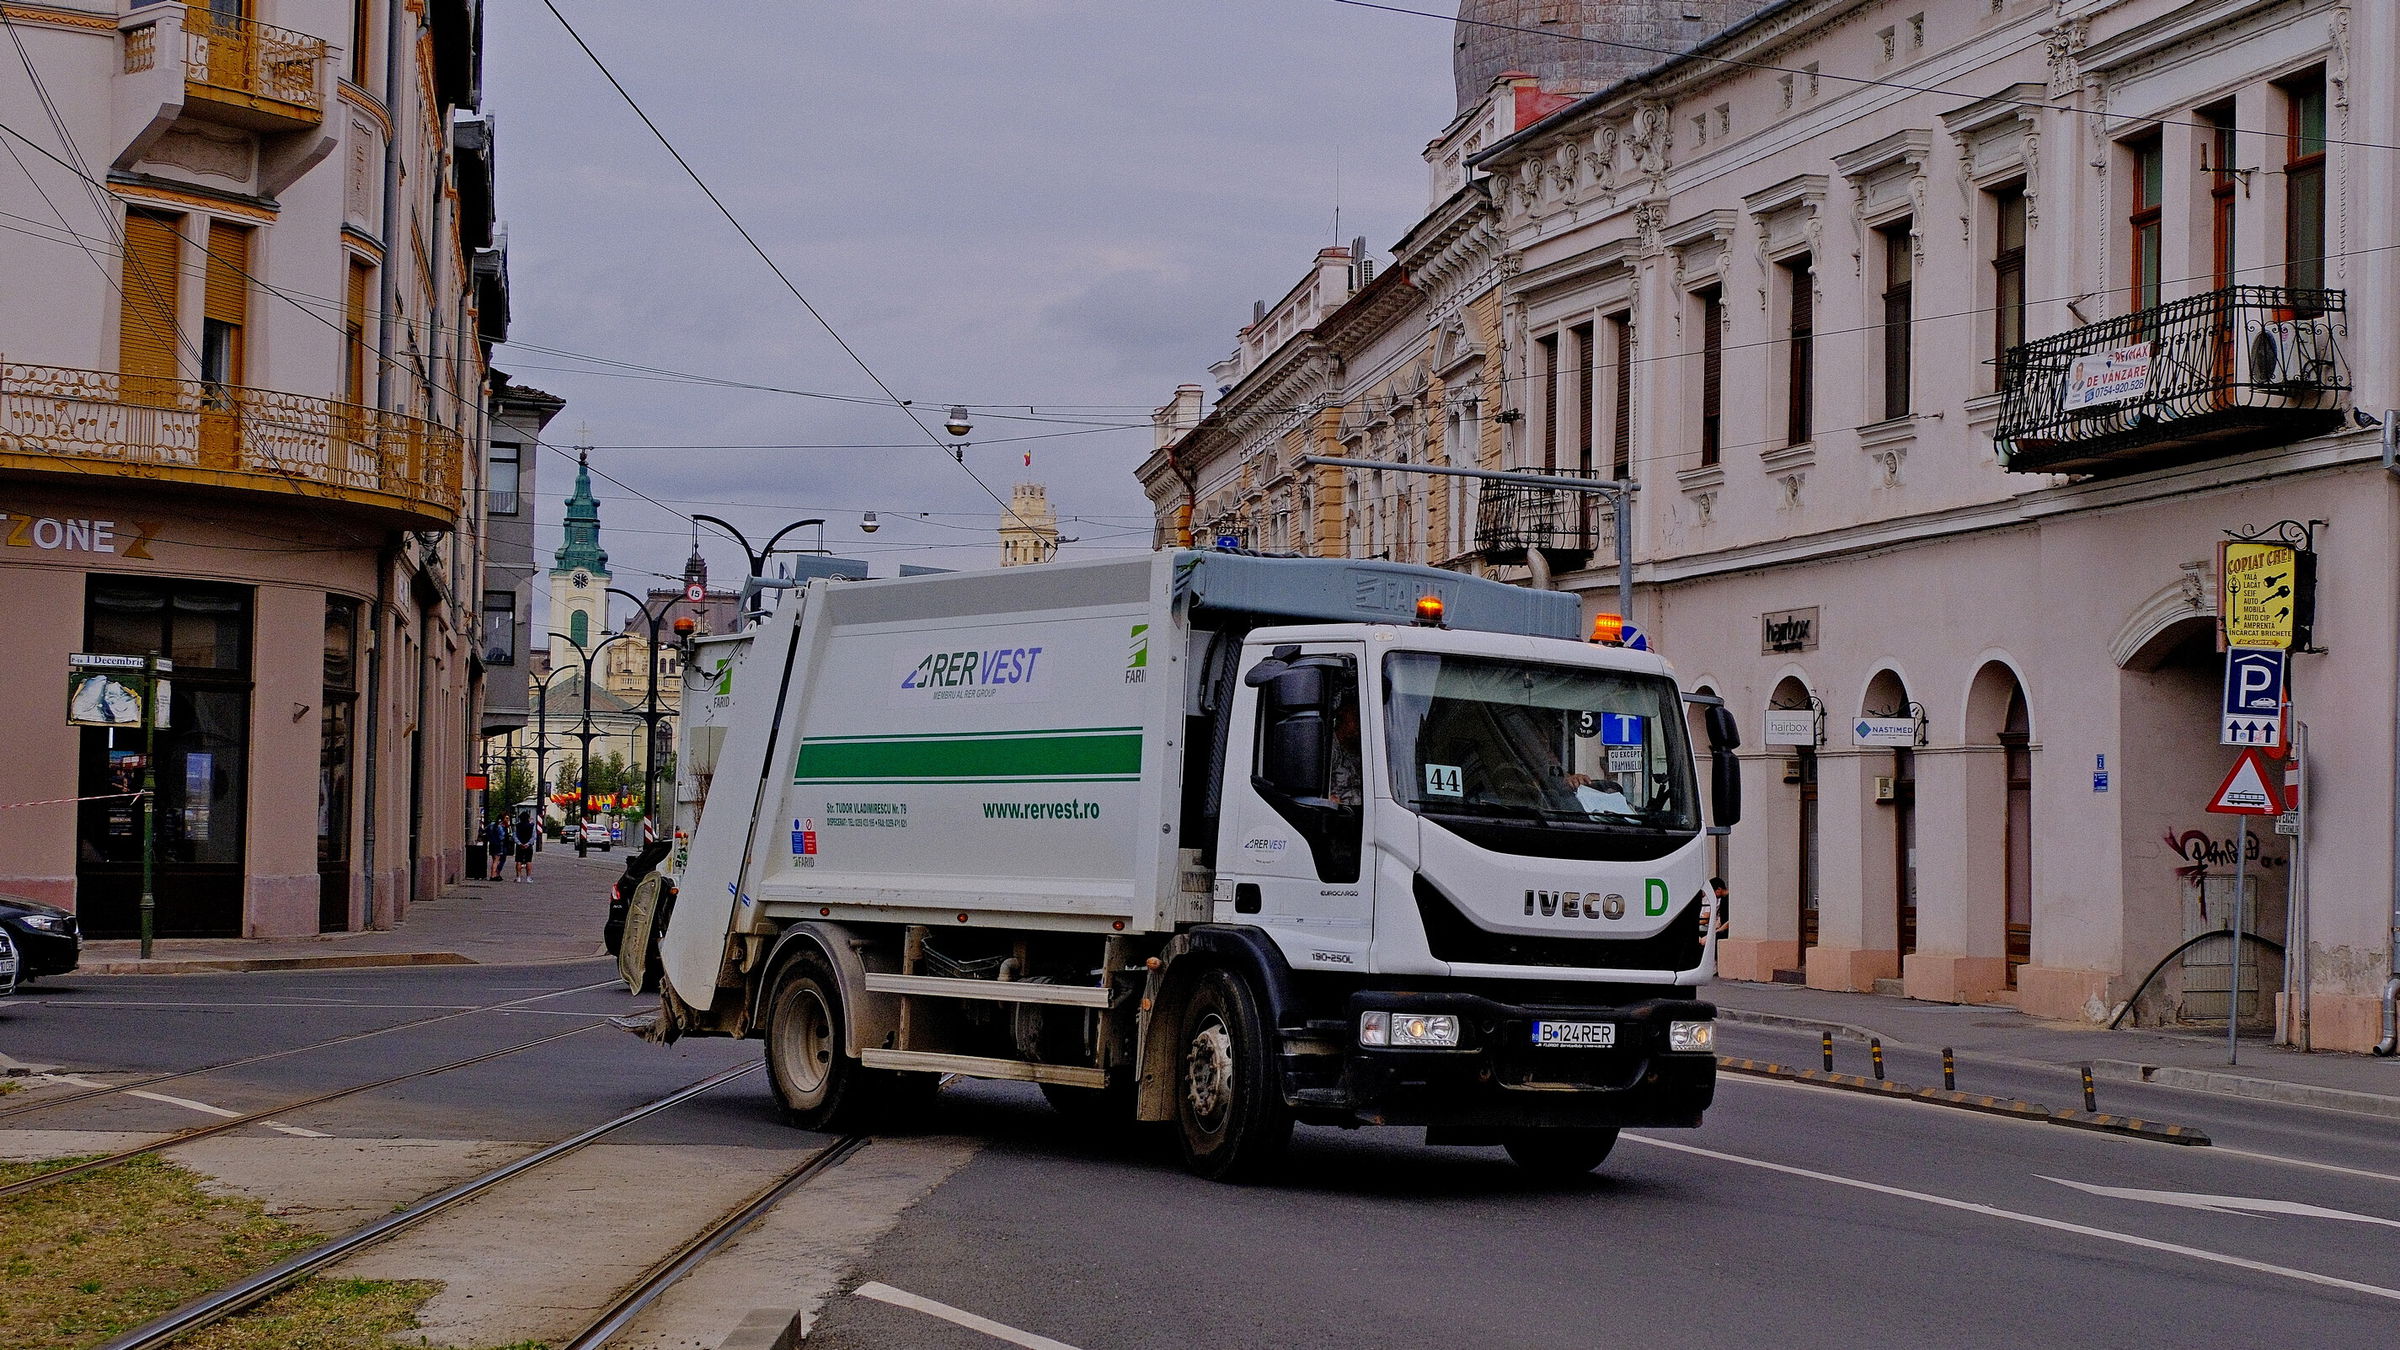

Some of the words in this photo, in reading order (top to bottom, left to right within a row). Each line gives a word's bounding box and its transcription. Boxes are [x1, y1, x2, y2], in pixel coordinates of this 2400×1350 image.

[2087, 375, 2098, 387] DE
[0, 513, 115, 552] ZONE
[2227, 553, 2265, 575] COPIAT
[2267, 548, 2292, 567] CHEI
[691, 589, 700, 598] 15
[1125, 669, 1147, 684] FARI
[2238, 664, 2272, 708] P
[714, 697, 730, 709] FARID
[1580, 710, 1593, 728] 5
[1770, 721, 1808, 733] hairbox
[1872, 725, 1913, 734] NASTIMED
[1430, 768, 1460, 792] 44
[983, 798, 1100, 819] www.rervest.ro
[798, 857, 815, 868] FARID
[1524, 889, 1626, 921] IVECO
[1644, 878, 1669, 917] D
